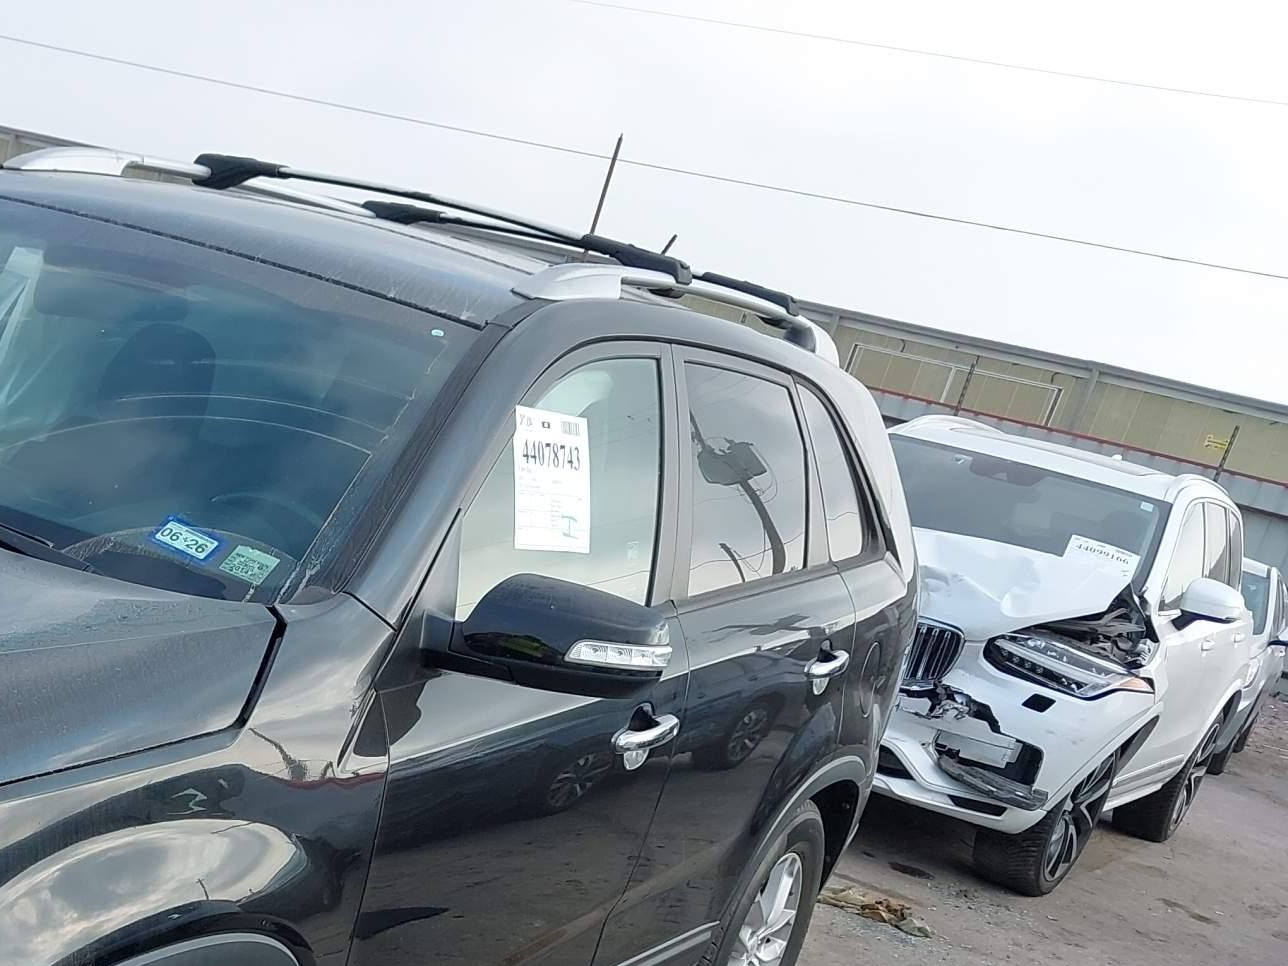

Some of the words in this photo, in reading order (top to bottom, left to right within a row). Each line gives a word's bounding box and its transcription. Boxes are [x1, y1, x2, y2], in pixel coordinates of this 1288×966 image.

[522, 439, 581, 471] 44078743
[160, 527, 183, 542] 06
[184, 538, 209, 554] 26
